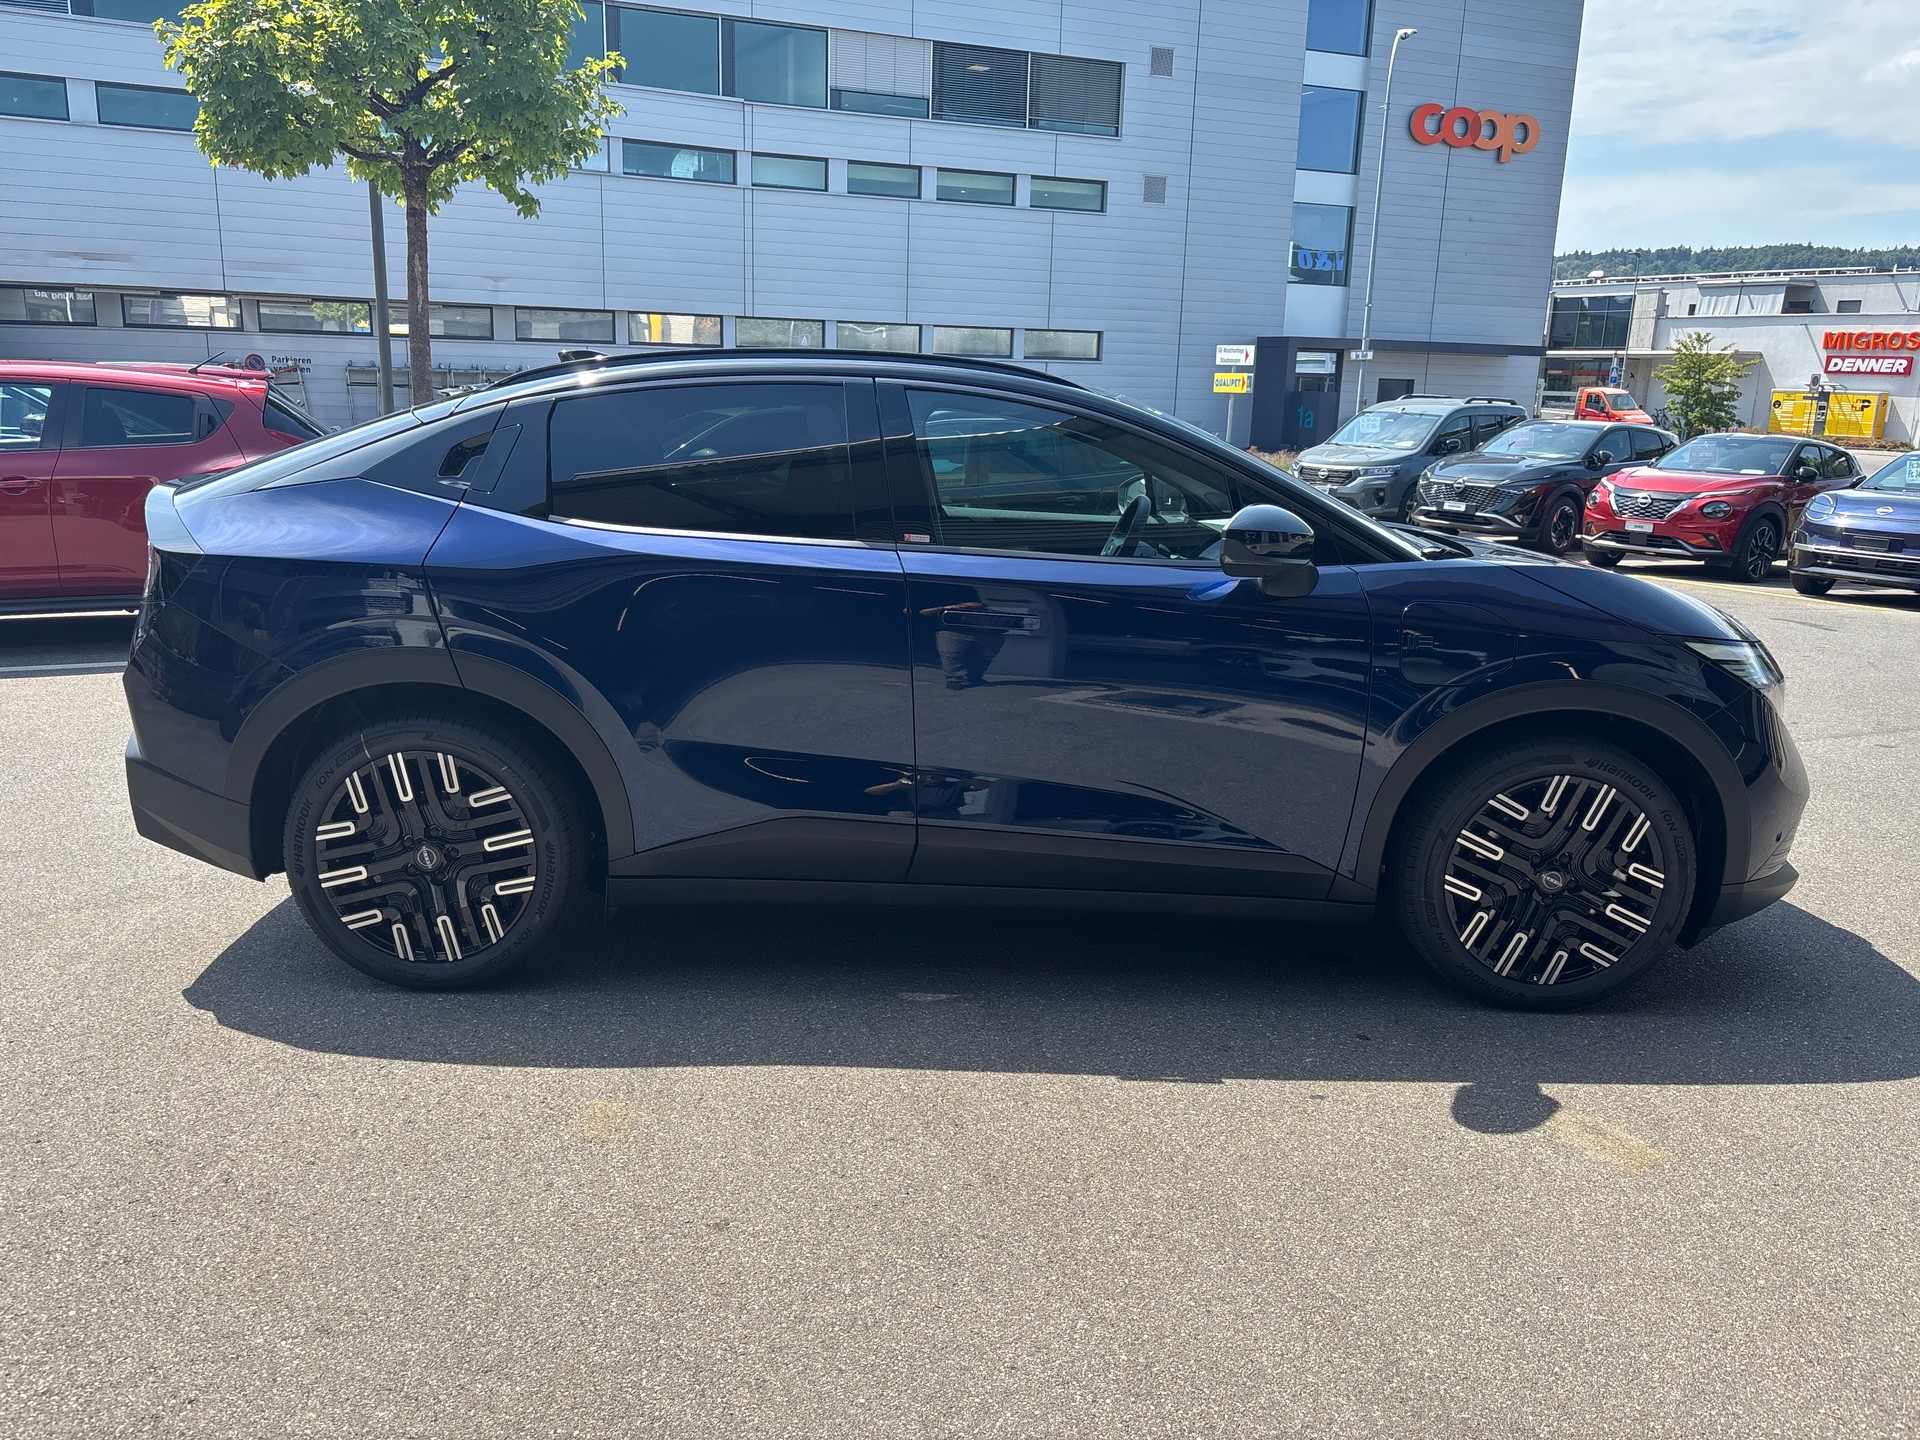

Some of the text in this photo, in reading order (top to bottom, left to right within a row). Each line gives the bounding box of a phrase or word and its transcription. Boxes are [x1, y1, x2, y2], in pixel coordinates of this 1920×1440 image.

[1409, 102, 1540, 164] coop
[1822, 331, 1920, 351] MIGROS
[271, 355, 312, 365] Parkieren
[1827, 358, 1908, 373] DENNER
[1215, 379, 1241, 388] QUALIPET
[1297, 405, 1314, 429] 1a
